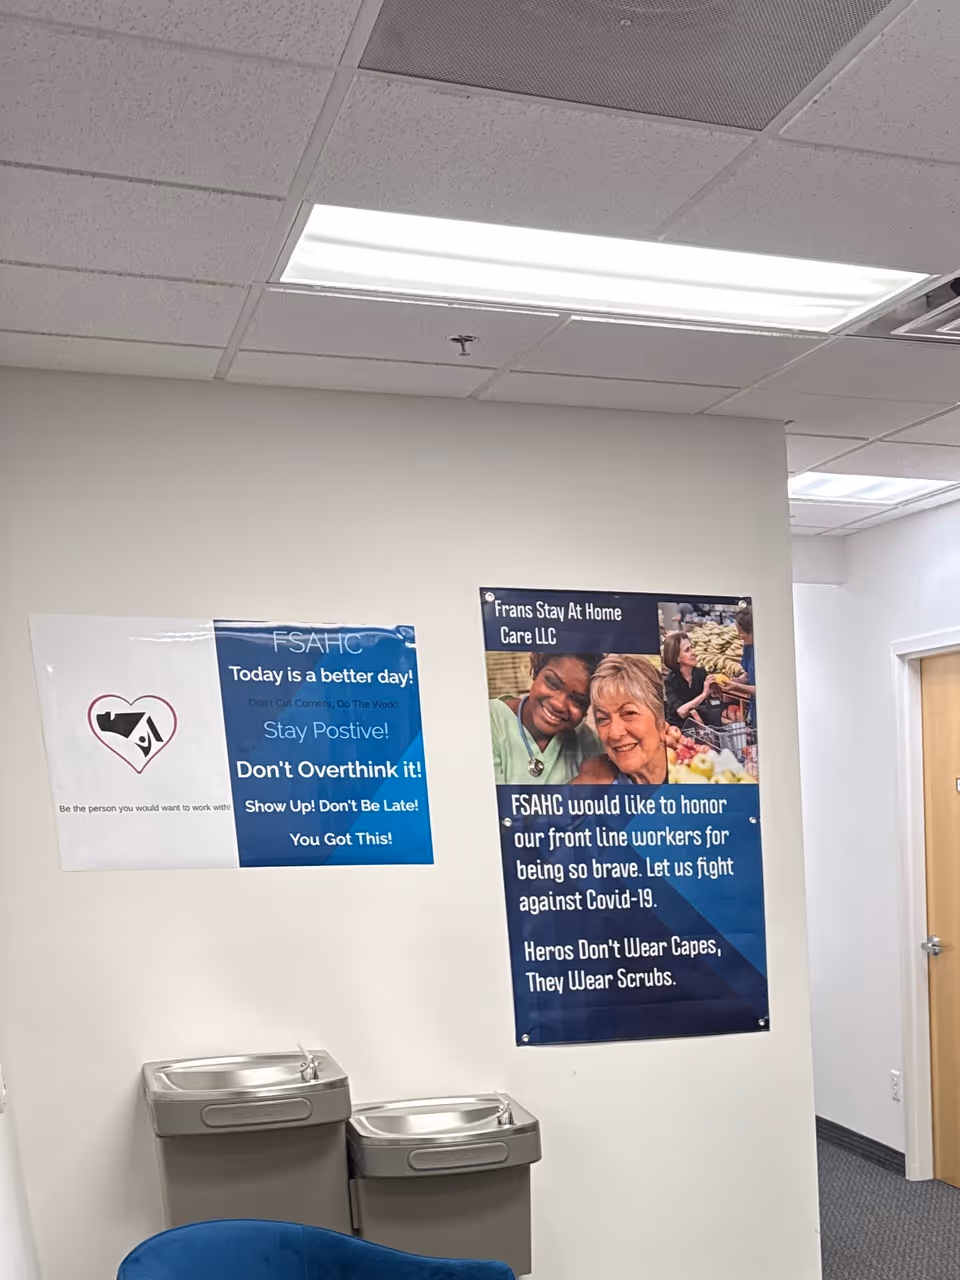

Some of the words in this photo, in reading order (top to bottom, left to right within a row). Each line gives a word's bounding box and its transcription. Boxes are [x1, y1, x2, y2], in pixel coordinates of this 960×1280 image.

[494, 600, 533, 618] Frans
[536, 601, 564, 622] Stay
[568, 602, 583, 620] At
[585, 603, 622, 621] Home
[273, 631, 363, 654] FSAHC
[500, 626, 532, 644] Care
[535, 627, 557, 645] LLC
[229, 666, 283, 686] Today
[287, 667, 301, 682] is
[305, 671, 316, 682] a
[320, 667, 373, 684] better
[377, 669, 414, 688] day!
[264, 721, 308, 743] Stay
[313, 721, 389, 740] Postive!
[236, 760, 293, 778] Don't
[297, 760, 399, 778] Overthink
[403, 760, 422, 778] it!
[59, 804, 71, 813] Be
[72, 804, 86, 813] the
[88, 805, 117, 814] person
[118, 805, 134, 814] you
[135, 804, 160, 813] would
[161, 804, 181, 812] want
[182, 804, 191, 812] to
[192, 803, 212, 811] work
[212, 803, 231, 811] with!
[245, 799, 286, 813] Show
[290, 799, 315, 815] Up!
[319, 799, 358, 812] Don't
[361, 799, 380, 812] Be
[383, 799, 419, 812] Late!
[511, 794, 563, 816] FSAHC
[567, 794, 620, 815] would
[624, 794, 655, 815] like
[659, 798, 676, 815] to
[680, 795, 727, 815] honor
[289, 832, 320, 846] You
[324, 832, 353, 846] Got
[355, 831, 393, 845] This!
[514, 831, 544, 848] our
[548, 828, 592, 850] front
[596, 827, 628, 848] line
[631, 827, 702, 847] workers
[705, 826, 729, 848] for
[516, 859, 564, 883] being
[568, 863, 588, 879] so
[592, 859, 642, 879] brave.
[646, 857, 671, 877] Let
[674, 861, 693, 876] us
[697, 856, 735, 879] fight
[519, 891, 582, 915] against
[586, 888, 657, 911] Covid-19.
[524, 941, 574, 961] Heros
[578, 939, 621, 959] Don't
[624, 937, 667, 958] Wear
[671, 935, 721, 958] Capes,
[525, 971, 564, 994] They
[568, 970, 613, 991] Wear
[617, 967, 677, 989] Scrubs.
